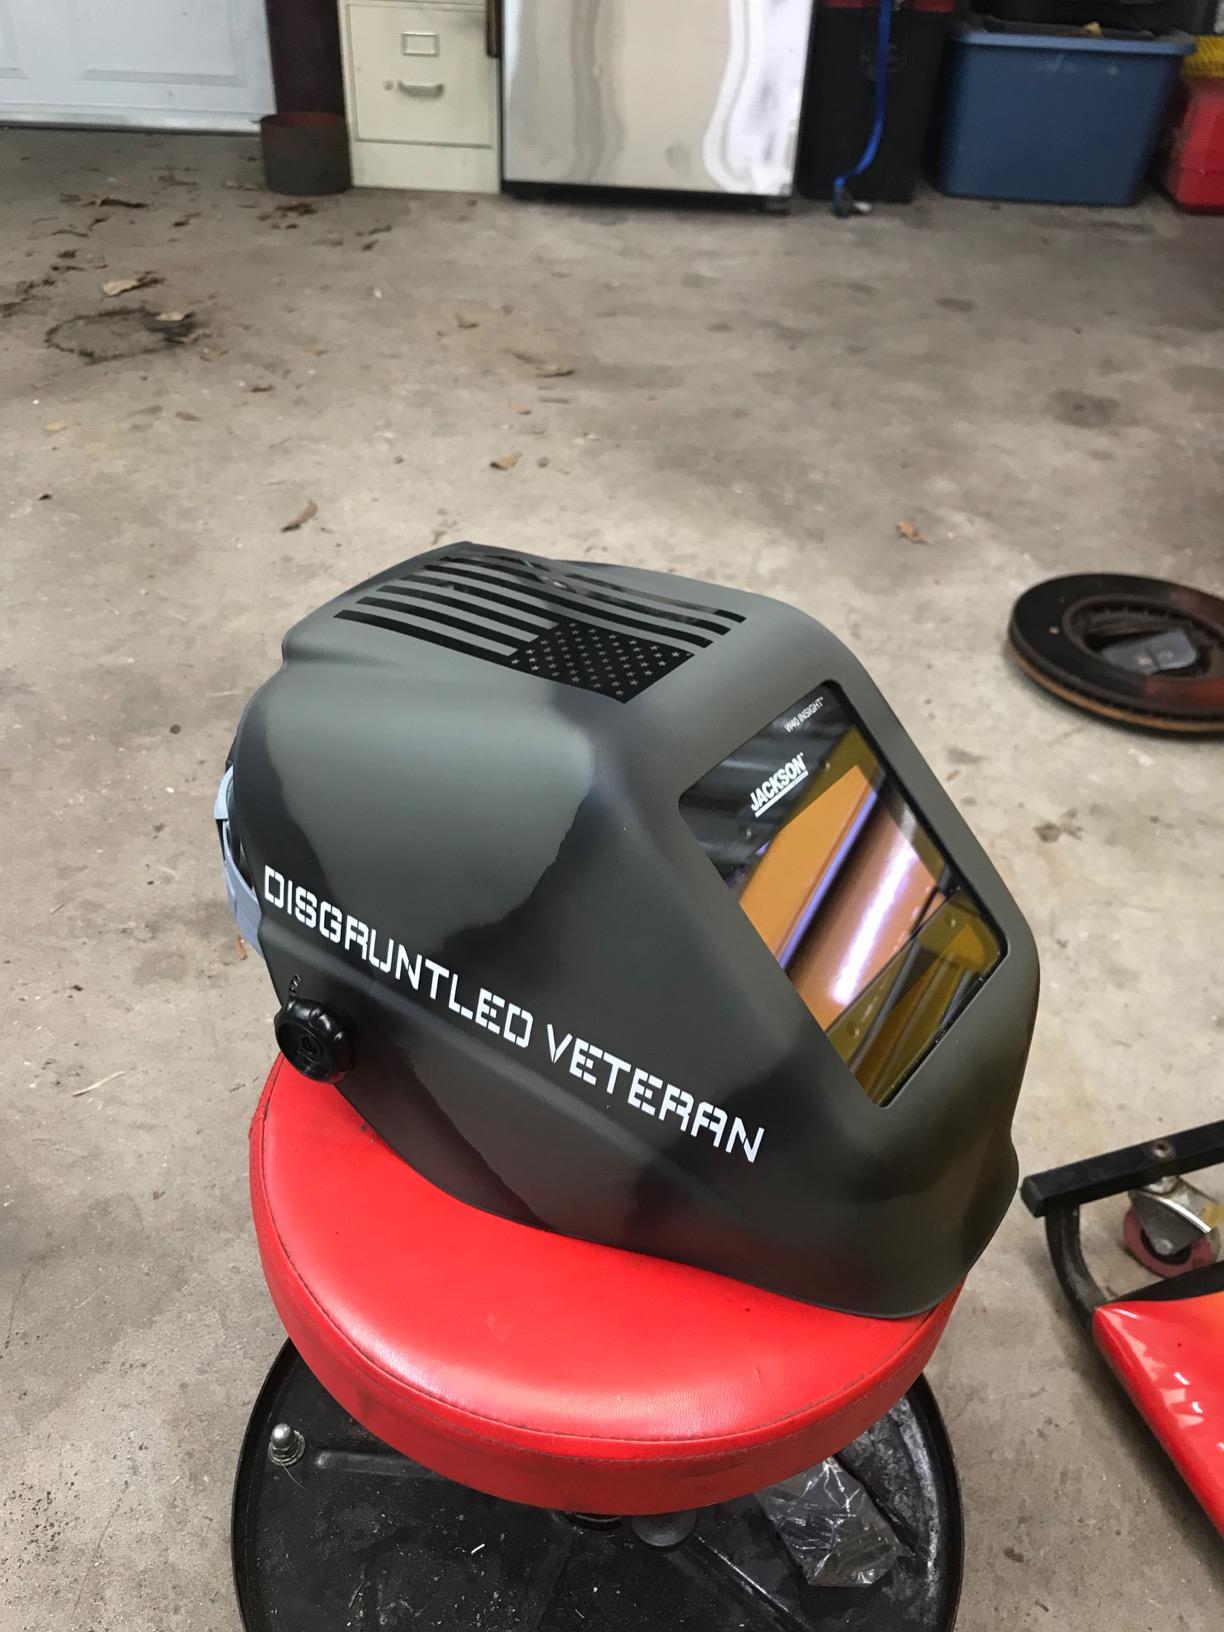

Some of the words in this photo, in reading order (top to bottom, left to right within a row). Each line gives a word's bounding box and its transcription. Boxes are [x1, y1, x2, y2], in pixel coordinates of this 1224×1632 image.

[784, 716, 800, 733] W40
[750, 754, 807, 812] JACKSON
[264, 865, 533, 1048] DISGRUNTLED
[547, 1024, 765, 1163] VETERAN
